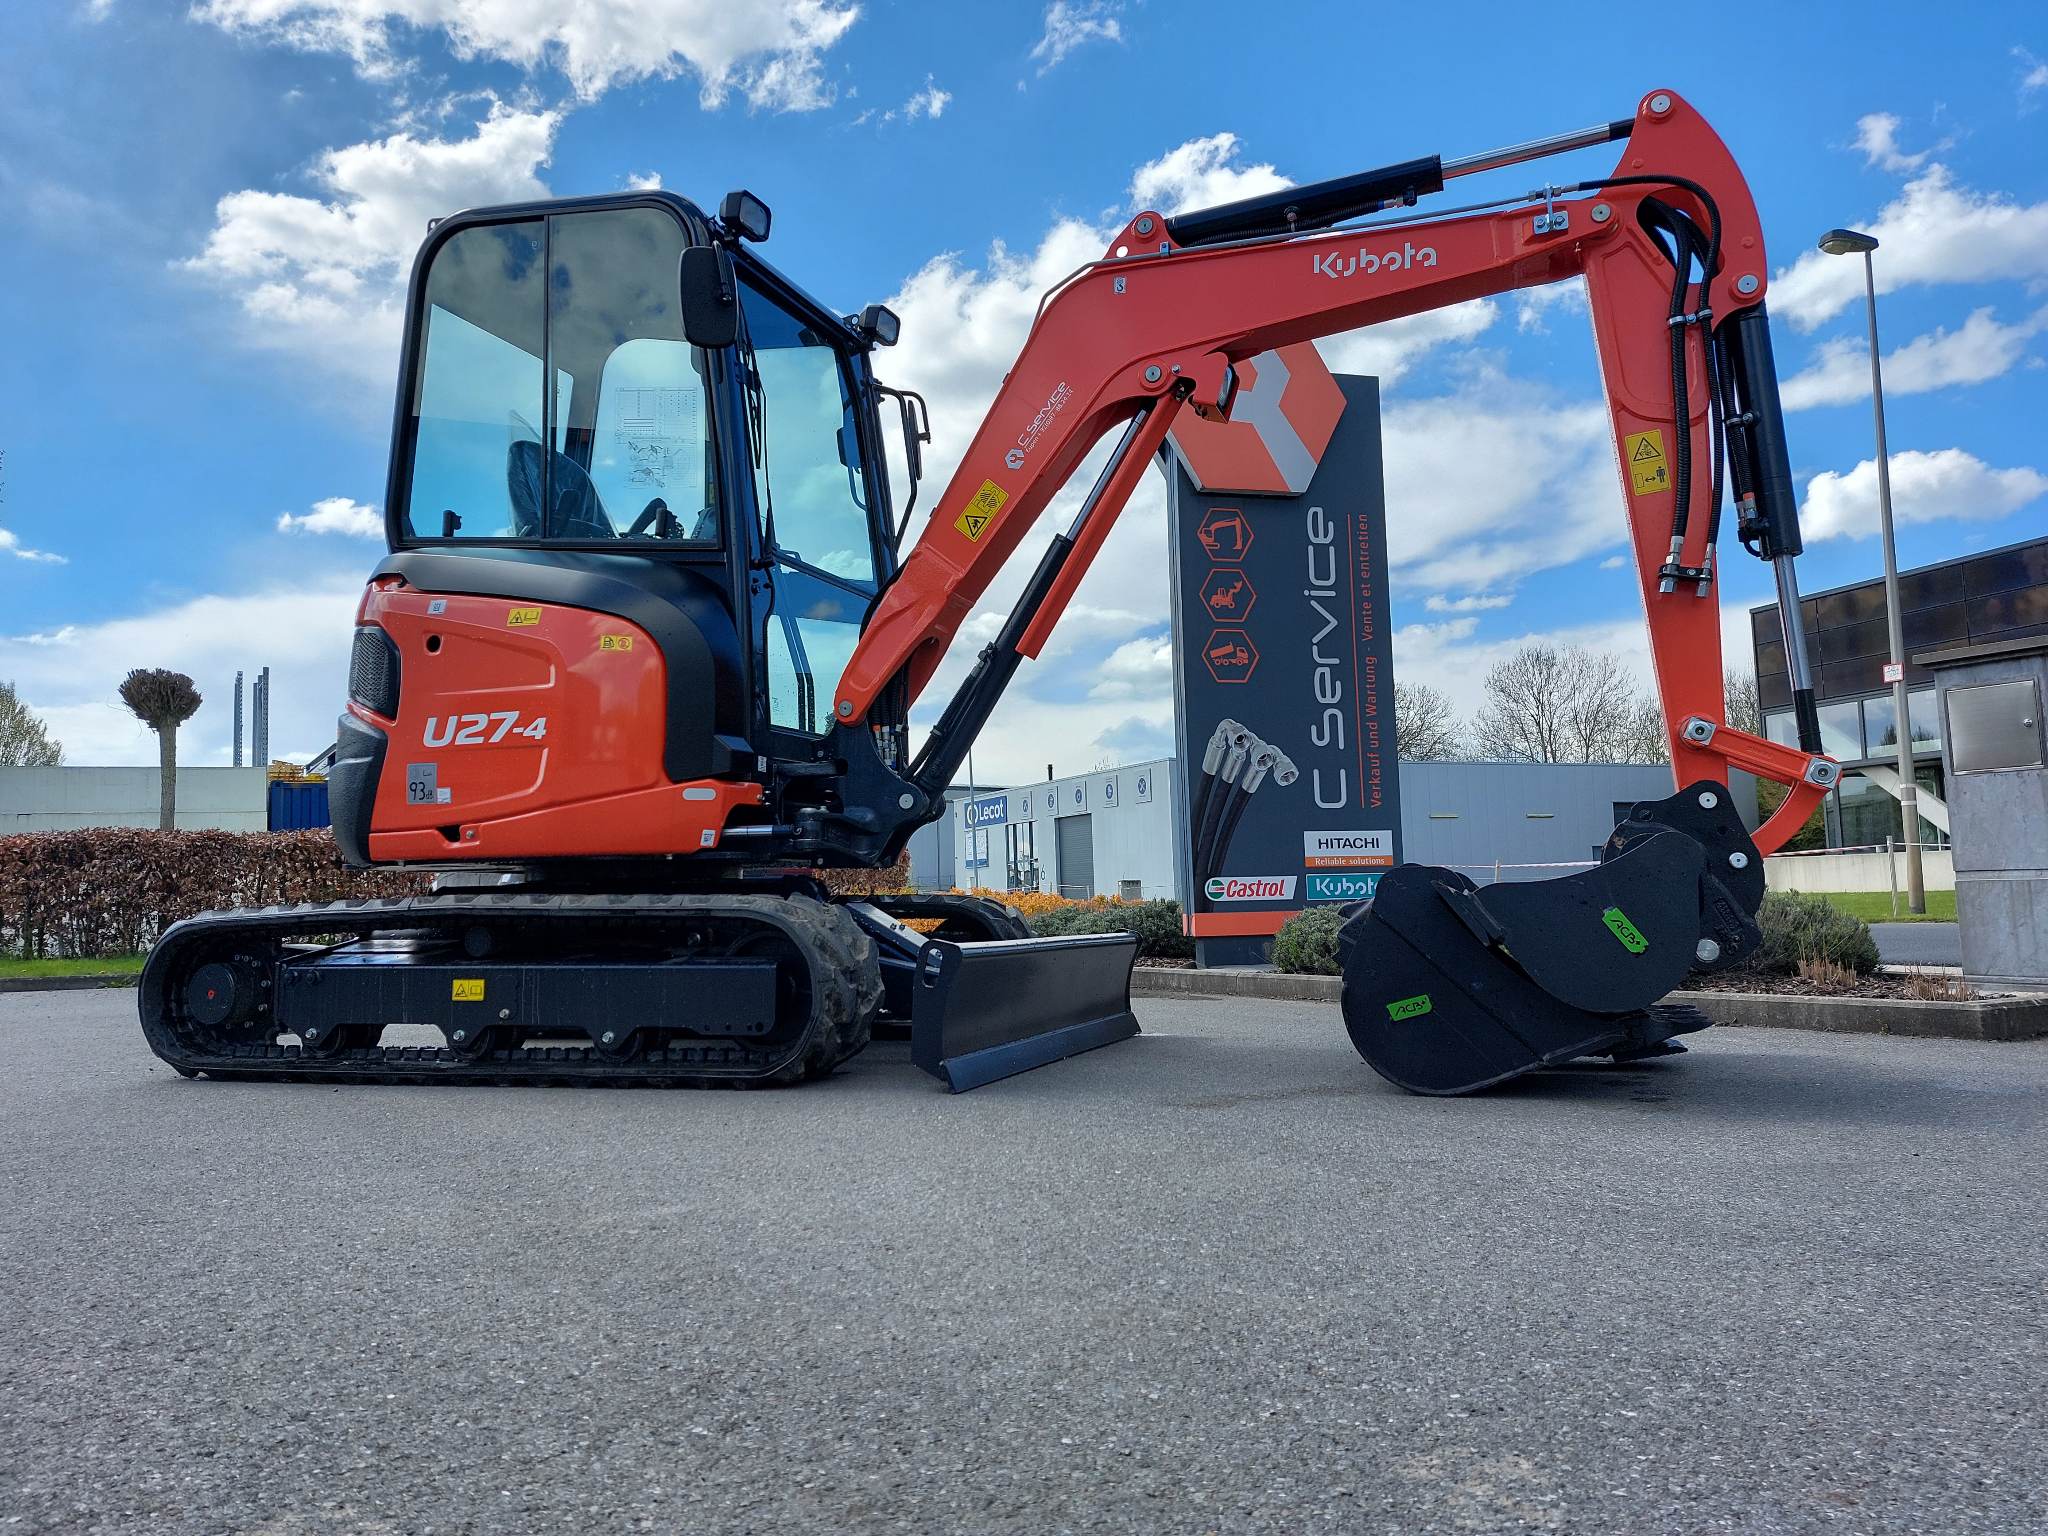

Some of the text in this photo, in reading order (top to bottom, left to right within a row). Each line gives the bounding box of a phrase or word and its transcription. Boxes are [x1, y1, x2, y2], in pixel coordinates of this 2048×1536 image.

[1313, 242, 1437, 279] Kubota
[1018, 381, 1066, 447] C Service
[1357, 513, 1382, 808] Verkauf und Wartung Vente et entretien
[423, 711, 547, 748] U27-4
[409, 781, 426, 800] 93
[1313, 768, 1347, 809] C
[979, 799, 1004, 821] Lecot
[1318, 837, 1380, 850] HITACHI
[1315, 857, 1385, 866] Reliable solutions
[1226, 879, 1285, 898] Castrol
